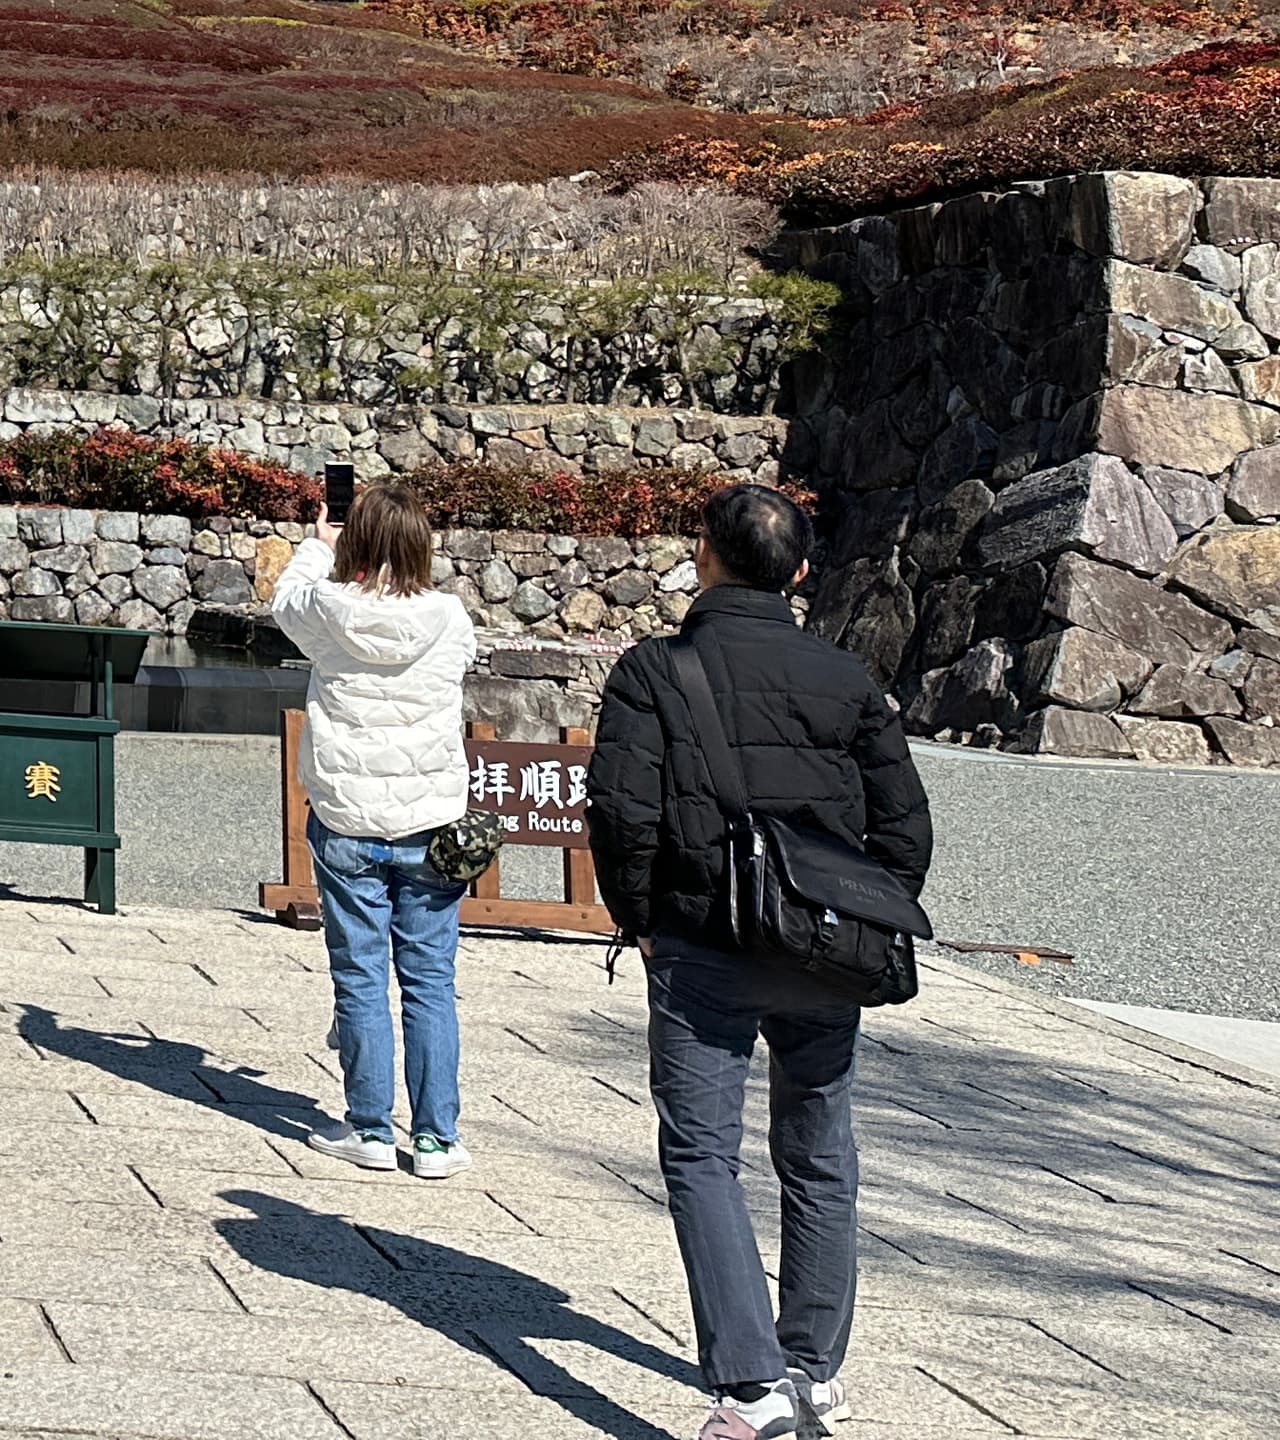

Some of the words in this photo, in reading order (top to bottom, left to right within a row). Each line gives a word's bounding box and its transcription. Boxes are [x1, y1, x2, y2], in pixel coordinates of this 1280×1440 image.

[469, 754, 593, 810] 拝順路
[498, 814, 520, 833] ng
[527, 810, 583, 833] Route
